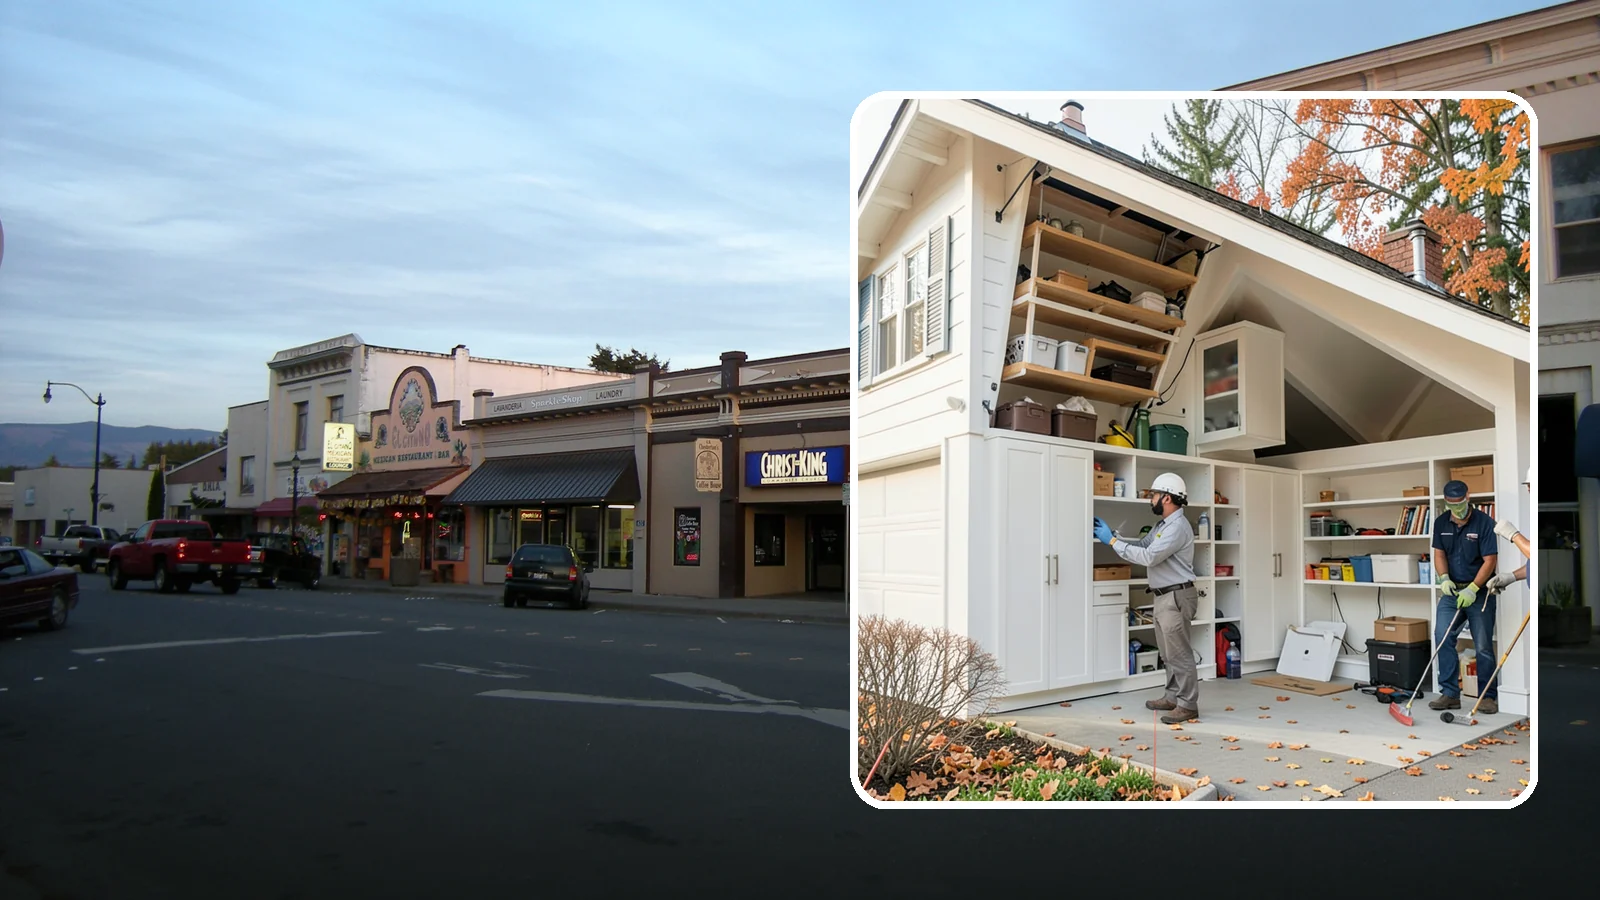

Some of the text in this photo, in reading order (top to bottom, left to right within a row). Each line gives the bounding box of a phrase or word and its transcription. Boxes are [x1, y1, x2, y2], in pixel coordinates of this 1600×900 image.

[595, 389, 623, 400] LAUNDRY
[493, 402, 523, 412] LAVANDERIA
[373, 454, 396, 464] MEXICAN
[397, 452, 433, 462] RESTAURANT
[438, 450, 450, 459] BAR
[761, 450, 827, 478] CHRIST KING
[697, 481, 709, 489] Coffee
